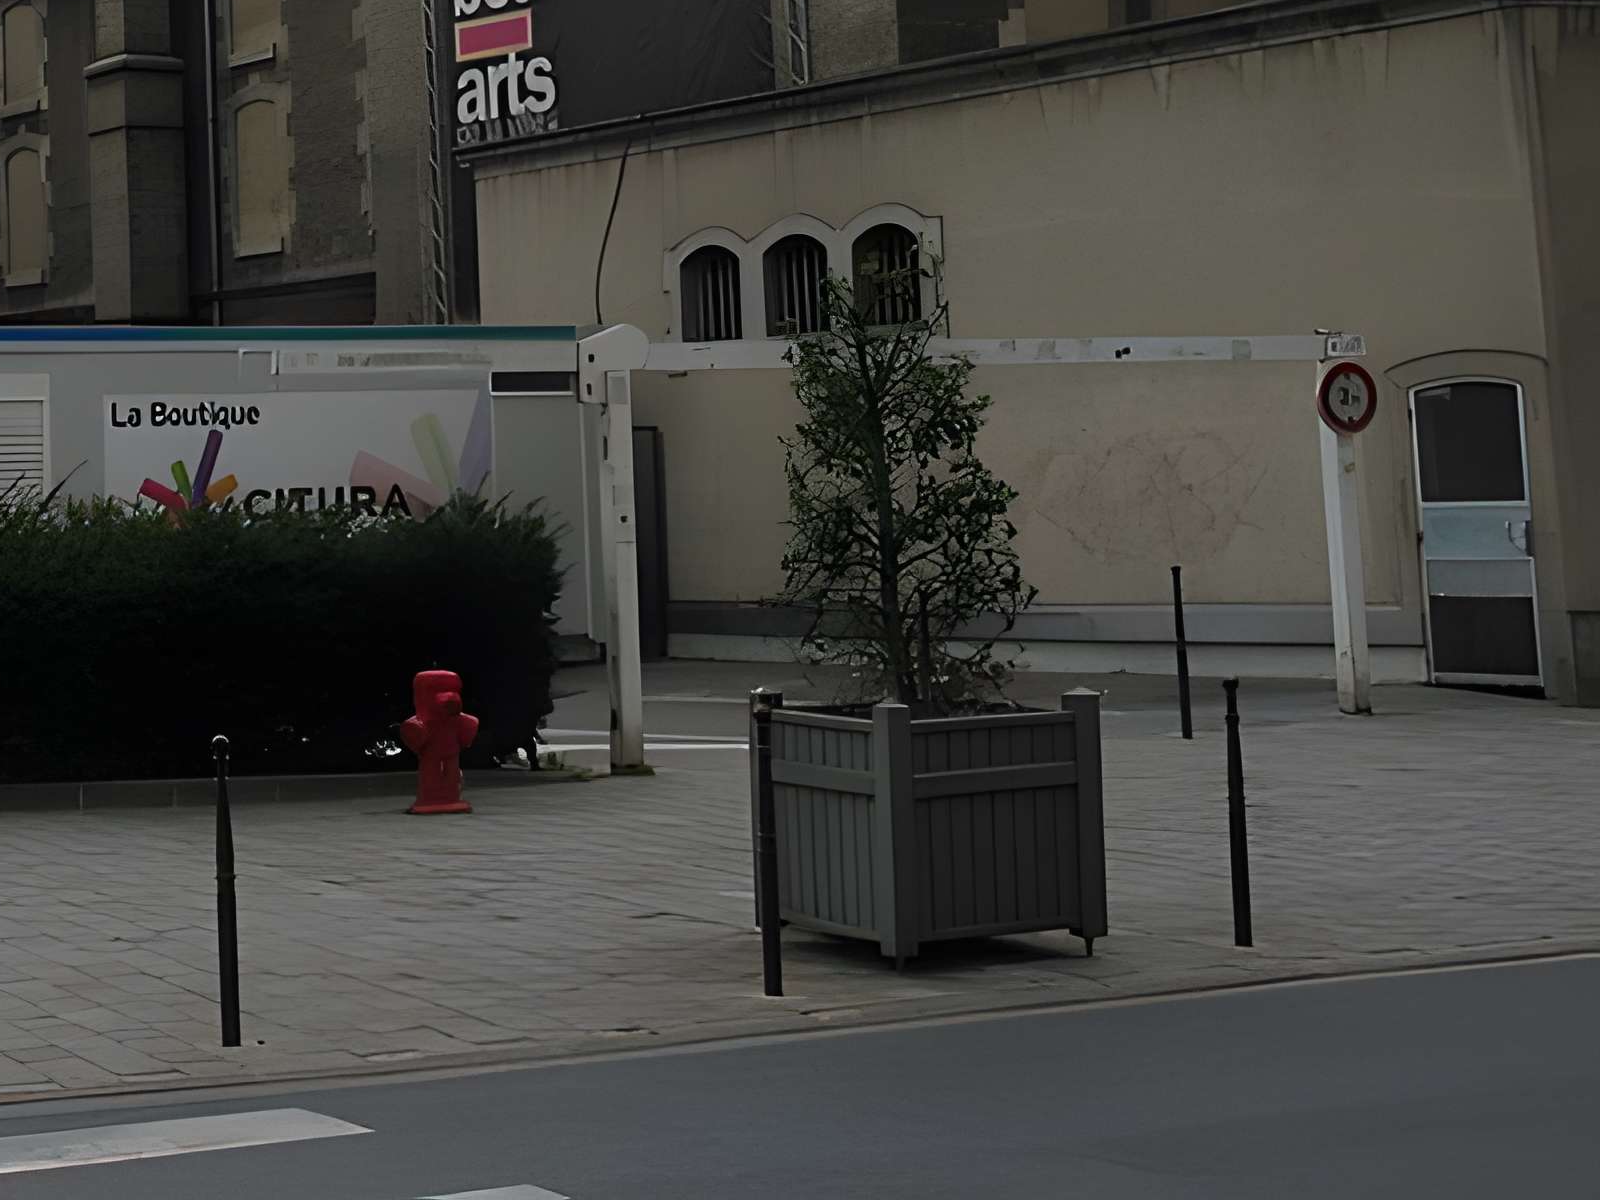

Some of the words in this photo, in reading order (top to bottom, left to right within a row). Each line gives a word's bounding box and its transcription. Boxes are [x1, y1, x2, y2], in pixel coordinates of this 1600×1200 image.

[457, 52, 555, 124] arts
[111, 402, 141, 427] La
[151, 401, 260, 430] Boutique
